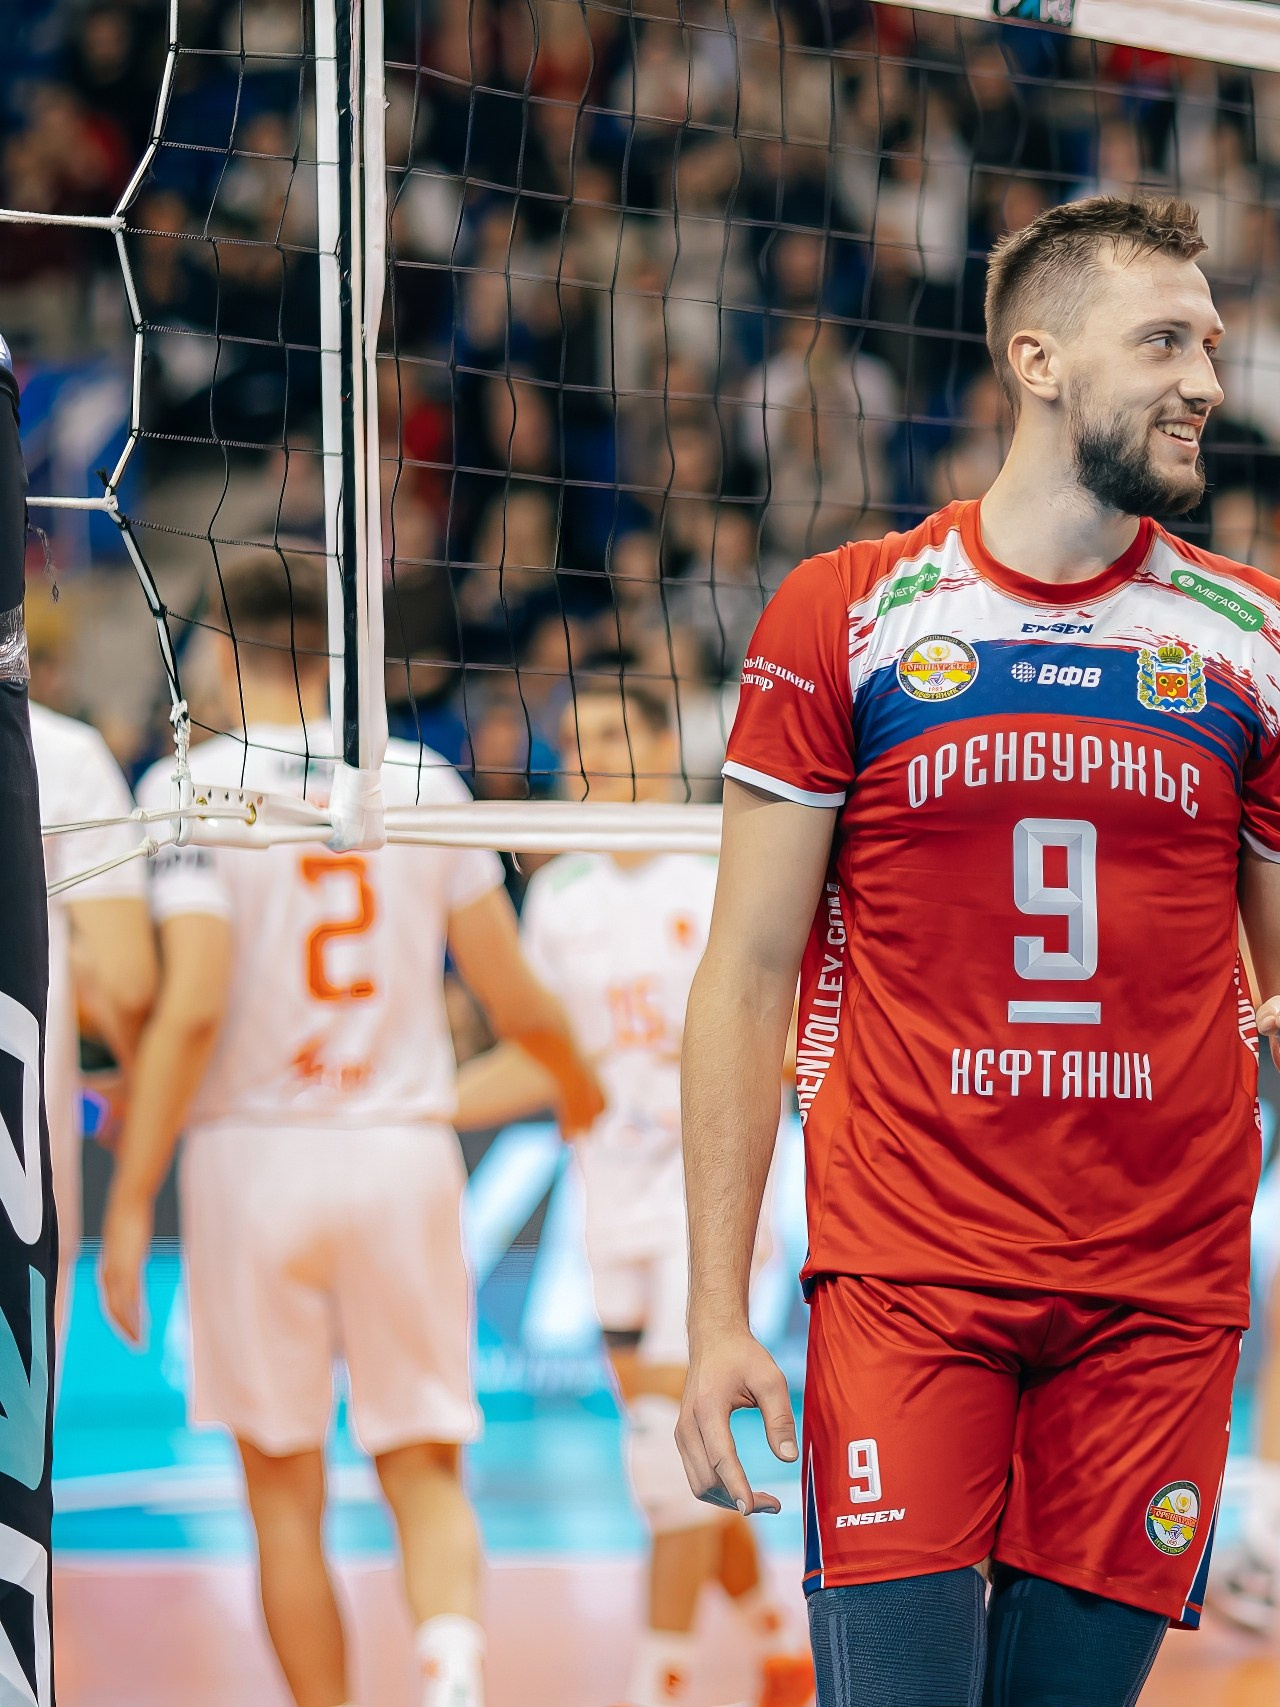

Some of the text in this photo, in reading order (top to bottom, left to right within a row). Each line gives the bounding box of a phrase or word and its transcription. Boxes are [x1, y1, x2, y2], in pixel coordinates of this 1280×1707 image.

[1021, 623, 1094, 634] ENSEN
[1194, 584, 1257, 625] МЕГАФОН
[1037, 663, 1102, 688] ВФВ
[907, 732, 1200, 819] ОРЕНБУРЖЬЕ
[1012, 817, 1098, 980] 9
[300, 855, 376, 1001] 2
[951, 1048, 1152, 1101] НЕФТЯНИК
[848, 1438, 882, 1503] 9
[836, 1508, 906, 1529] ENSEN
